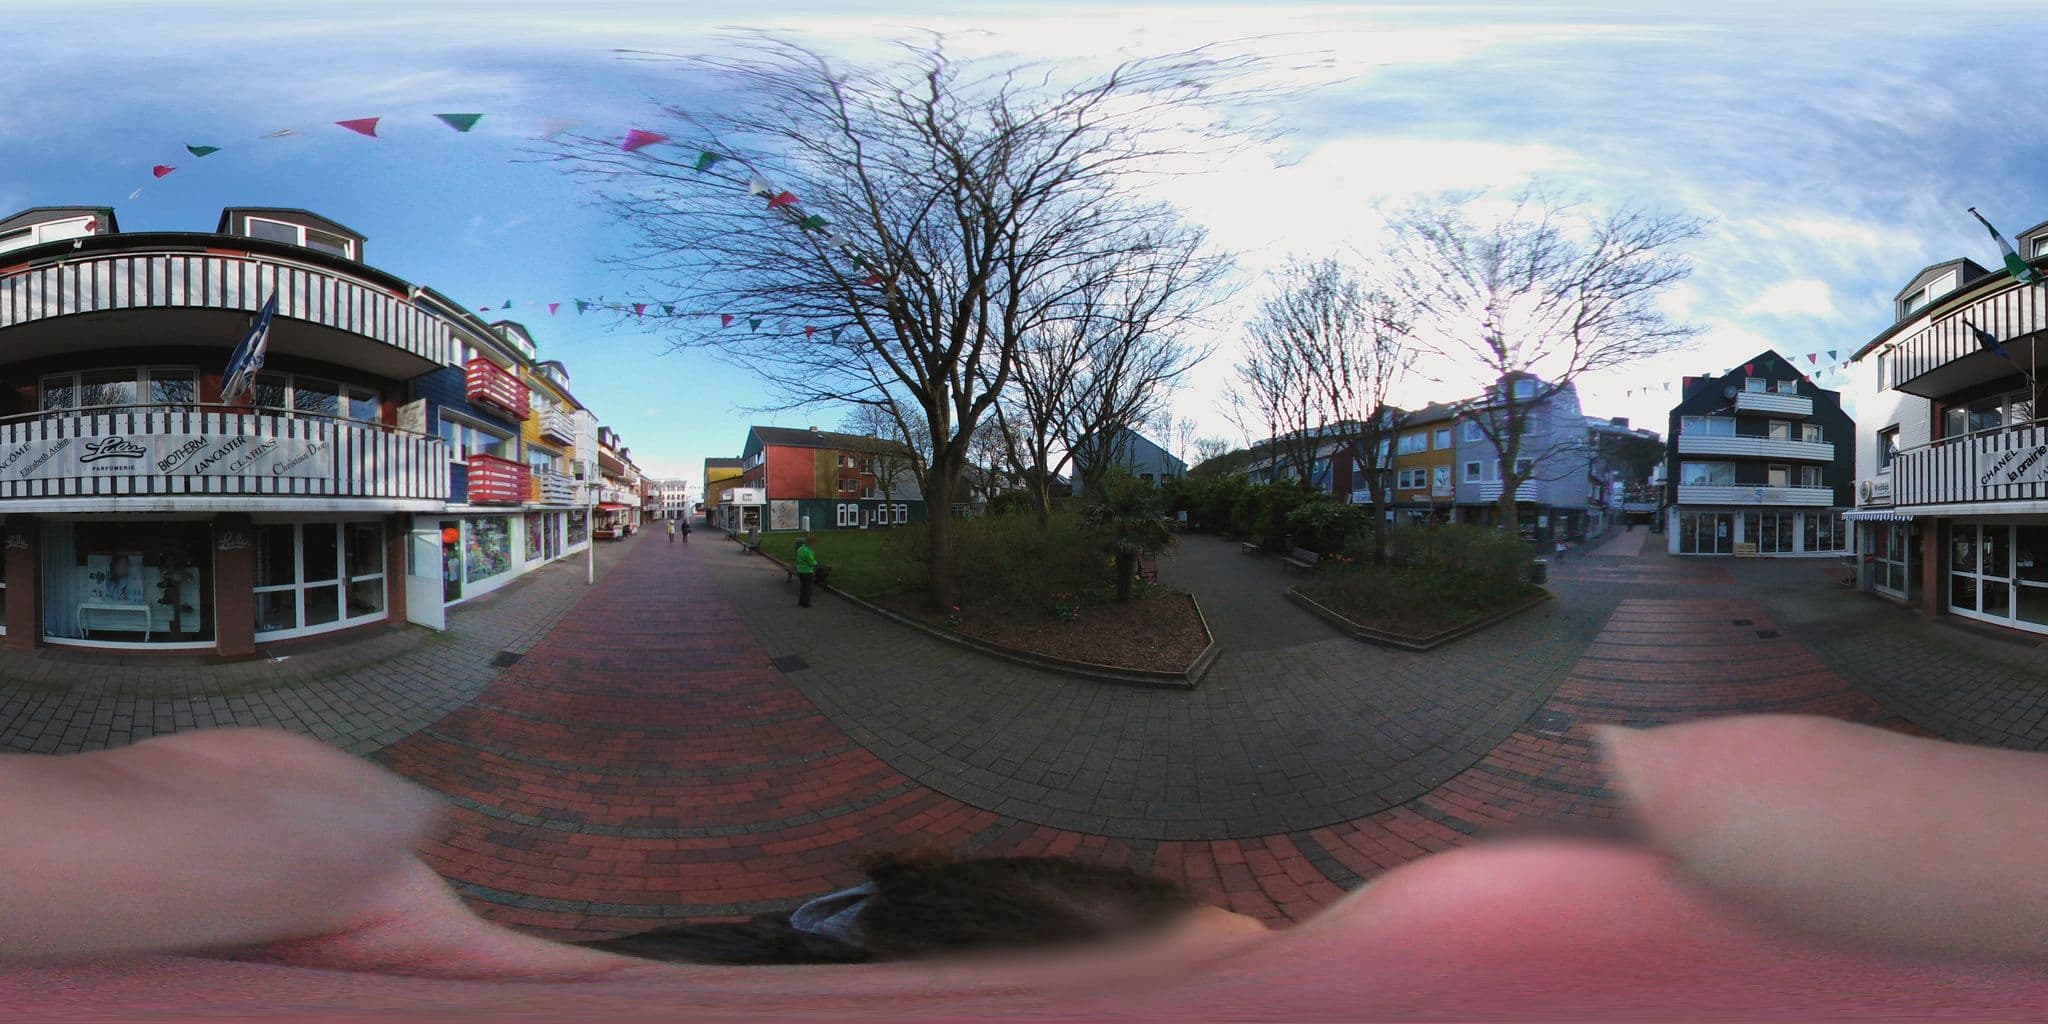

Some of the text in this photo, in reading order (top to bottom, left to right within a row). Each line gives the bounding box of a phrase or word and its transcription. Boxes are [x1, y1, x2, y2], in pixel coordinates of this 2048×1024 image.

[19, 438, 71, 478] Elizabeth Arden
[157, 436, 209, 473] BIOTHERM
[194, 436, 247, 475] LANCASTER
[229, 439, 278, 472] CLARINS
[272, 453, 309, 476] Christian
[1981, 450, 2018, 485] CHANEL
[2007, 446, 2047, 482] la prairie
